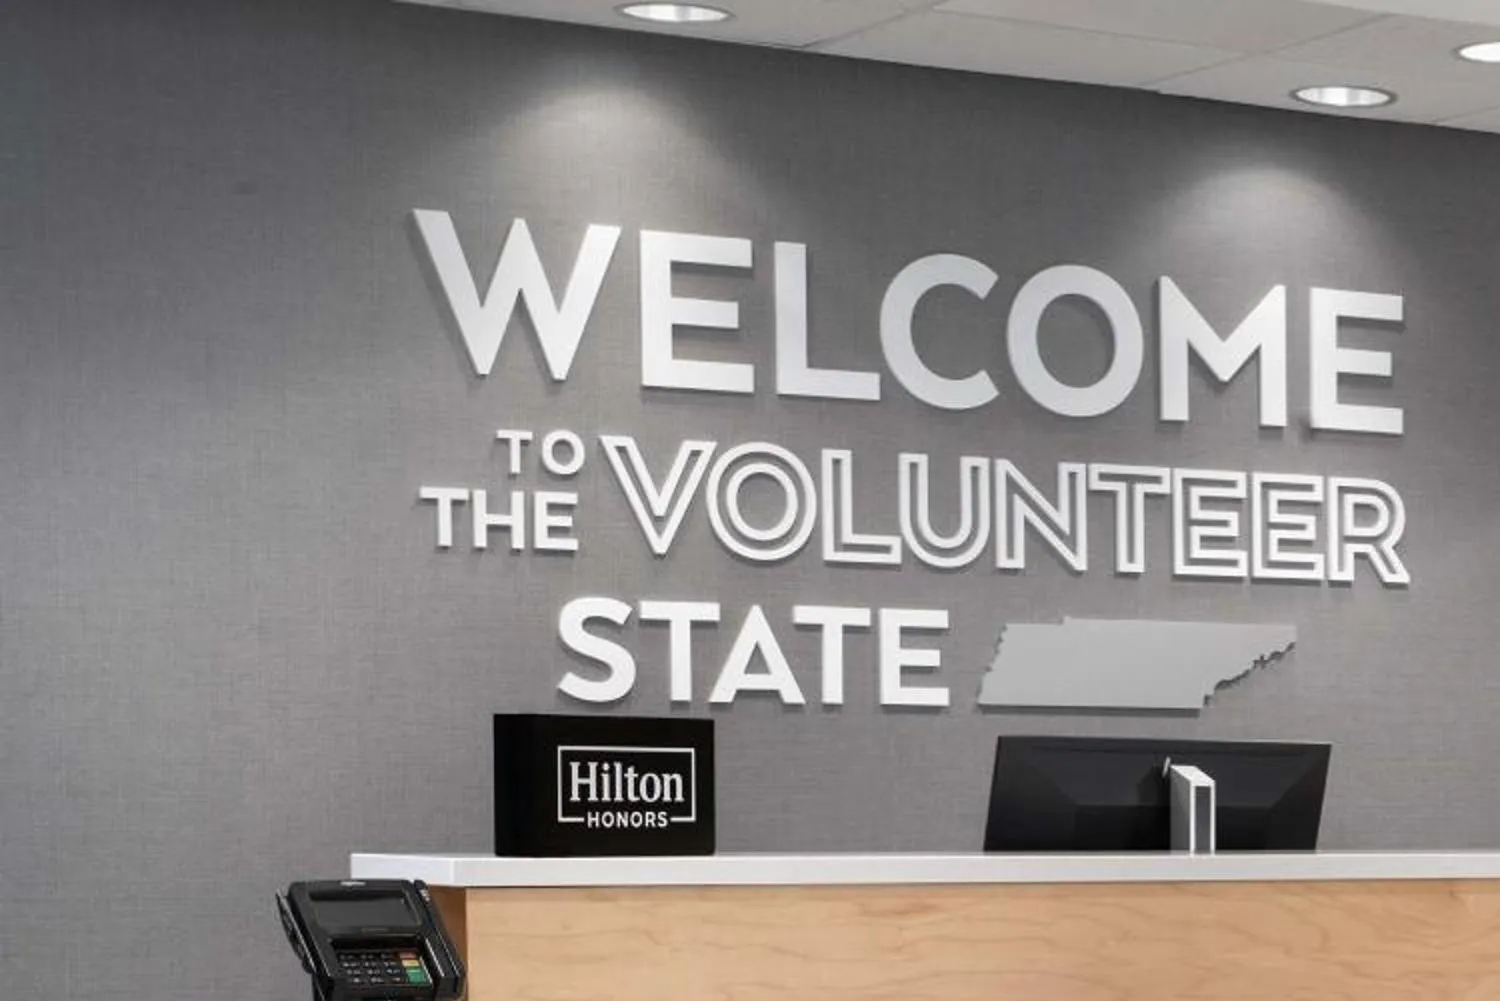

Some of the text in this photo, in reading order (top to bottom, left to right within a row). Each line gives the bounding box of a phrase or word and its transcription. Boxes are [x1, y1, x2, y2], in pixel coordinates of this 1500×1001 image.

[413, 209, 1404, 434] WELCOME
[497, 430, 585, 475] TO
[419, 486, 580, 551] THE
[600, 434, 1410, 584] VOLUNTEER
[556, 597, 950, 707] STATE
[569, 761, 685, 803] Hilton
[586, 811, 669, 829] HONORS
